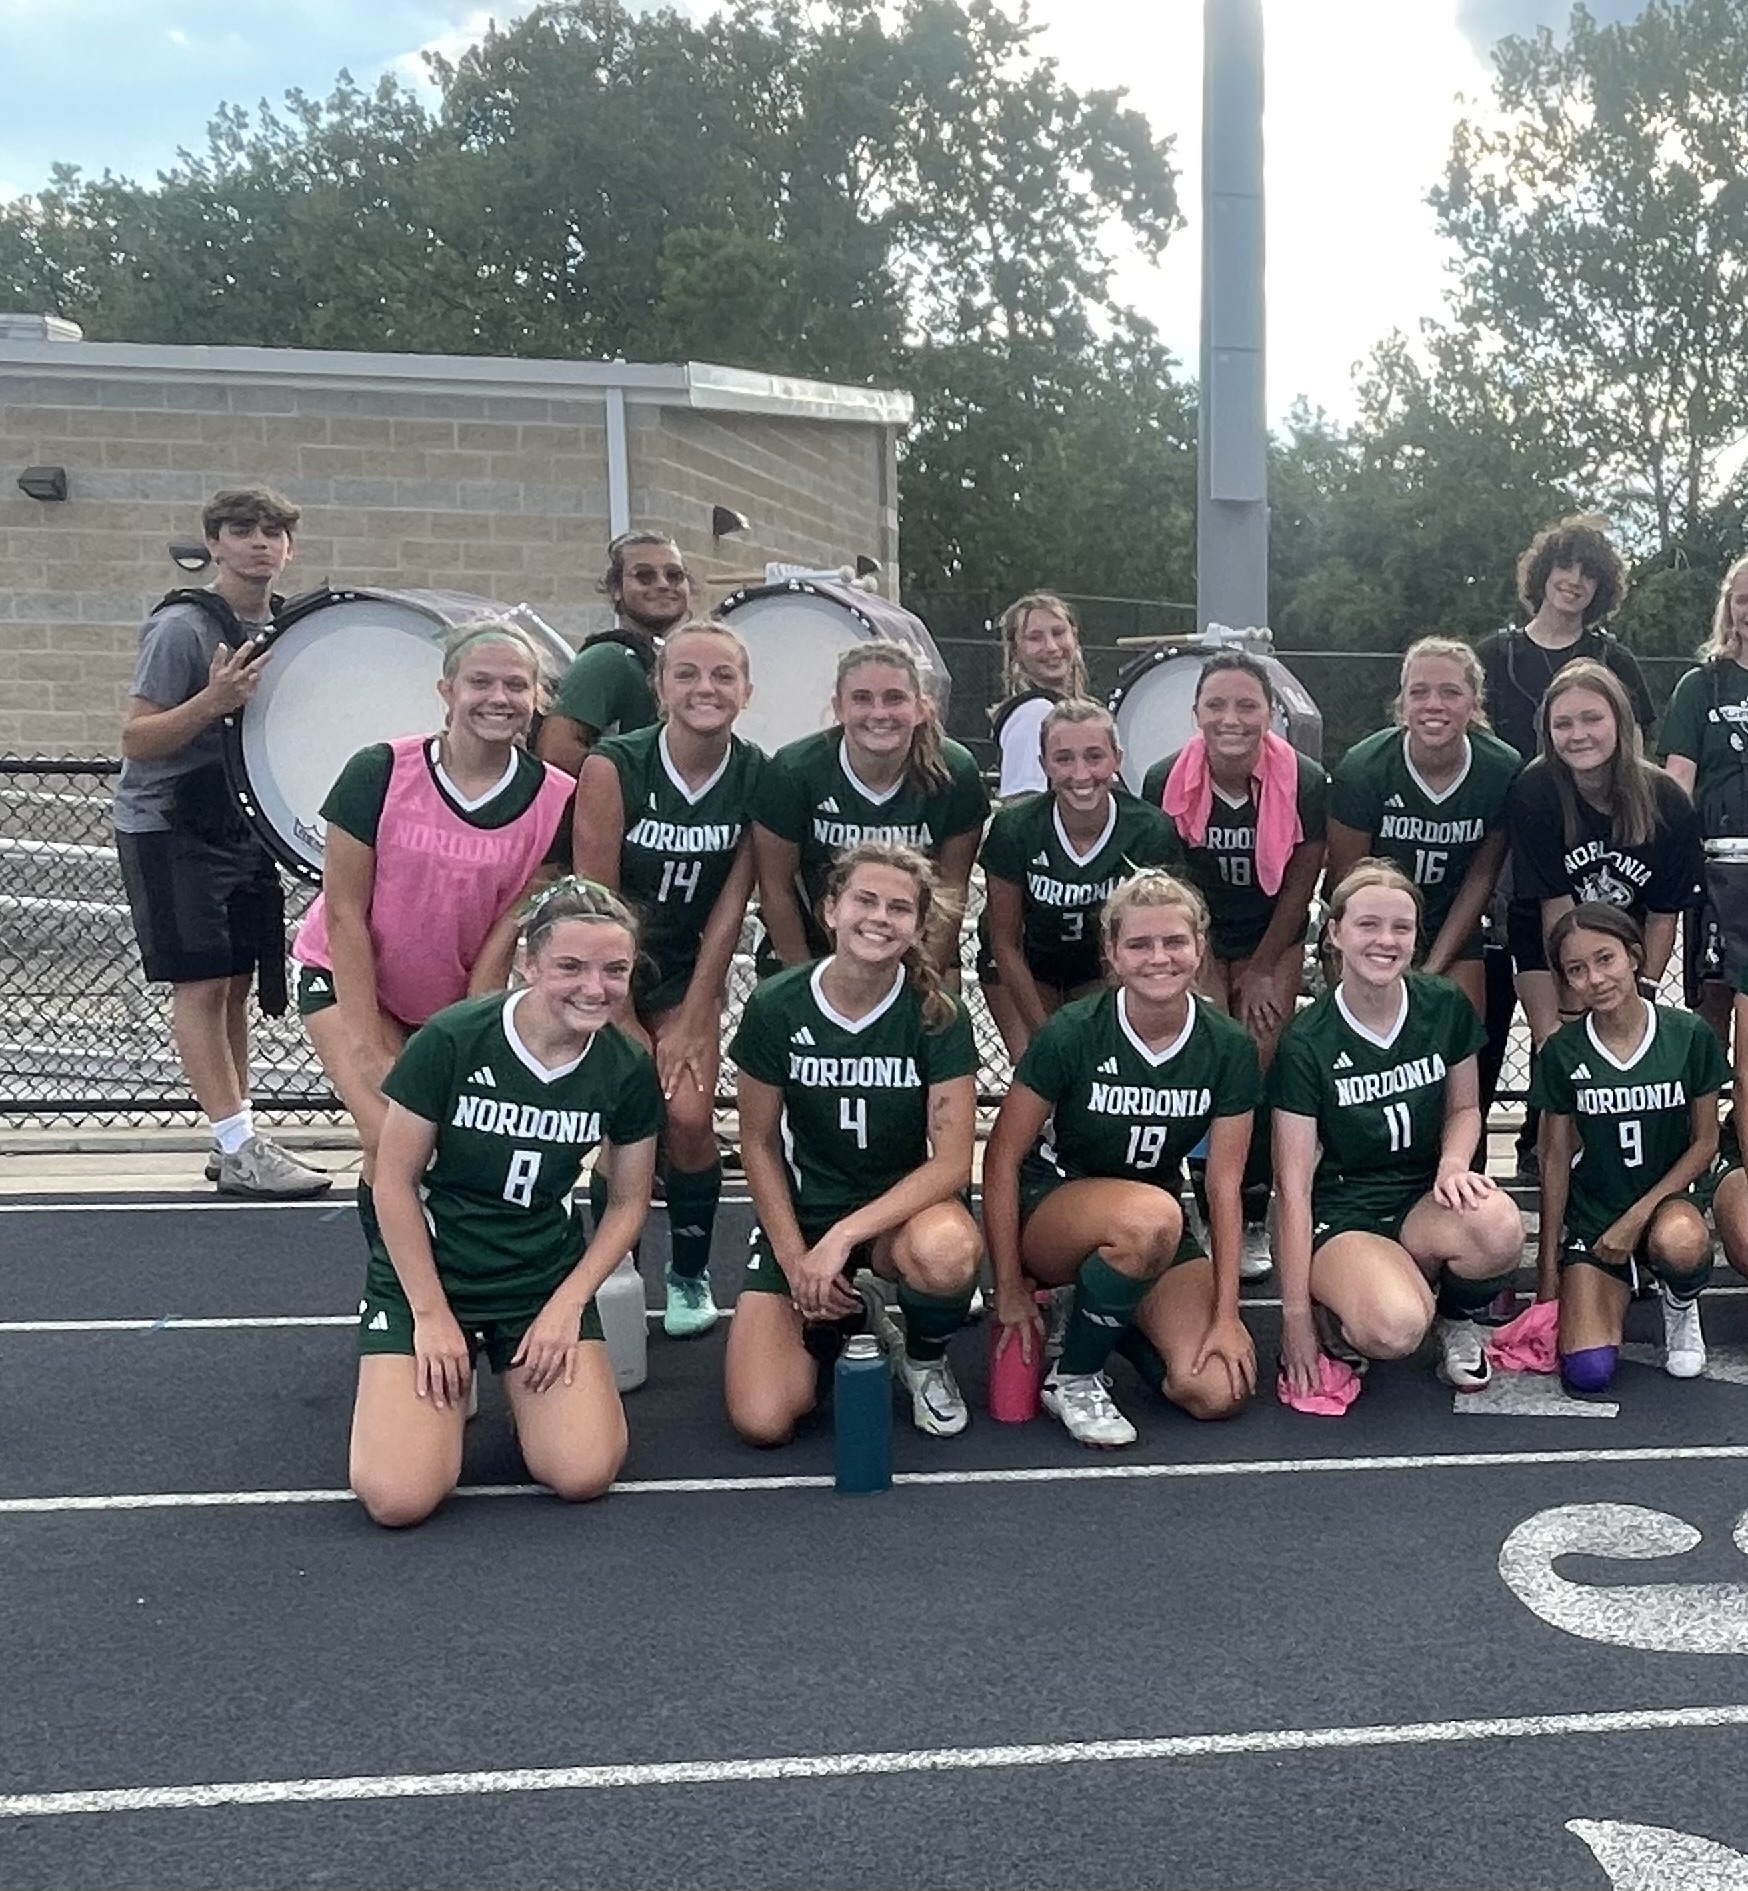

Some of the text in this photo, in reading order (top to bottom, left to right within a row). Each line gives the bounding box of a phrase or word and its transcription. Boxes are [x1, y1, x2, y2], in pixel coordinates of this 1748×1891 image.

[812, 818, 934, 850] NORDONIA
[1379, 814, 1484, 846] NORDONIA
[658, 860, 702, 903] 14
[1218, 856, 1251, 886] 18
[1414, 849, 1448, 885] 16
[1061, 912, 1085, 942] 3
[788, 1052, 922, 1088] NORDONIA
[1334, 1053, 1446, 1107] NORDONIA
[452, 1094, 601, 1144] NORDONIA
[1087, 1082, 1211, 1118] NORDONIA
[839, 1097, 868, 1149] 4
[1383, 1102, 1412, 1152] 11
[1619, 1120, 1644, 1168] 9
[1125, 1125, 1168, 1169] 19
[503, 1150, 542, 1208] 8
